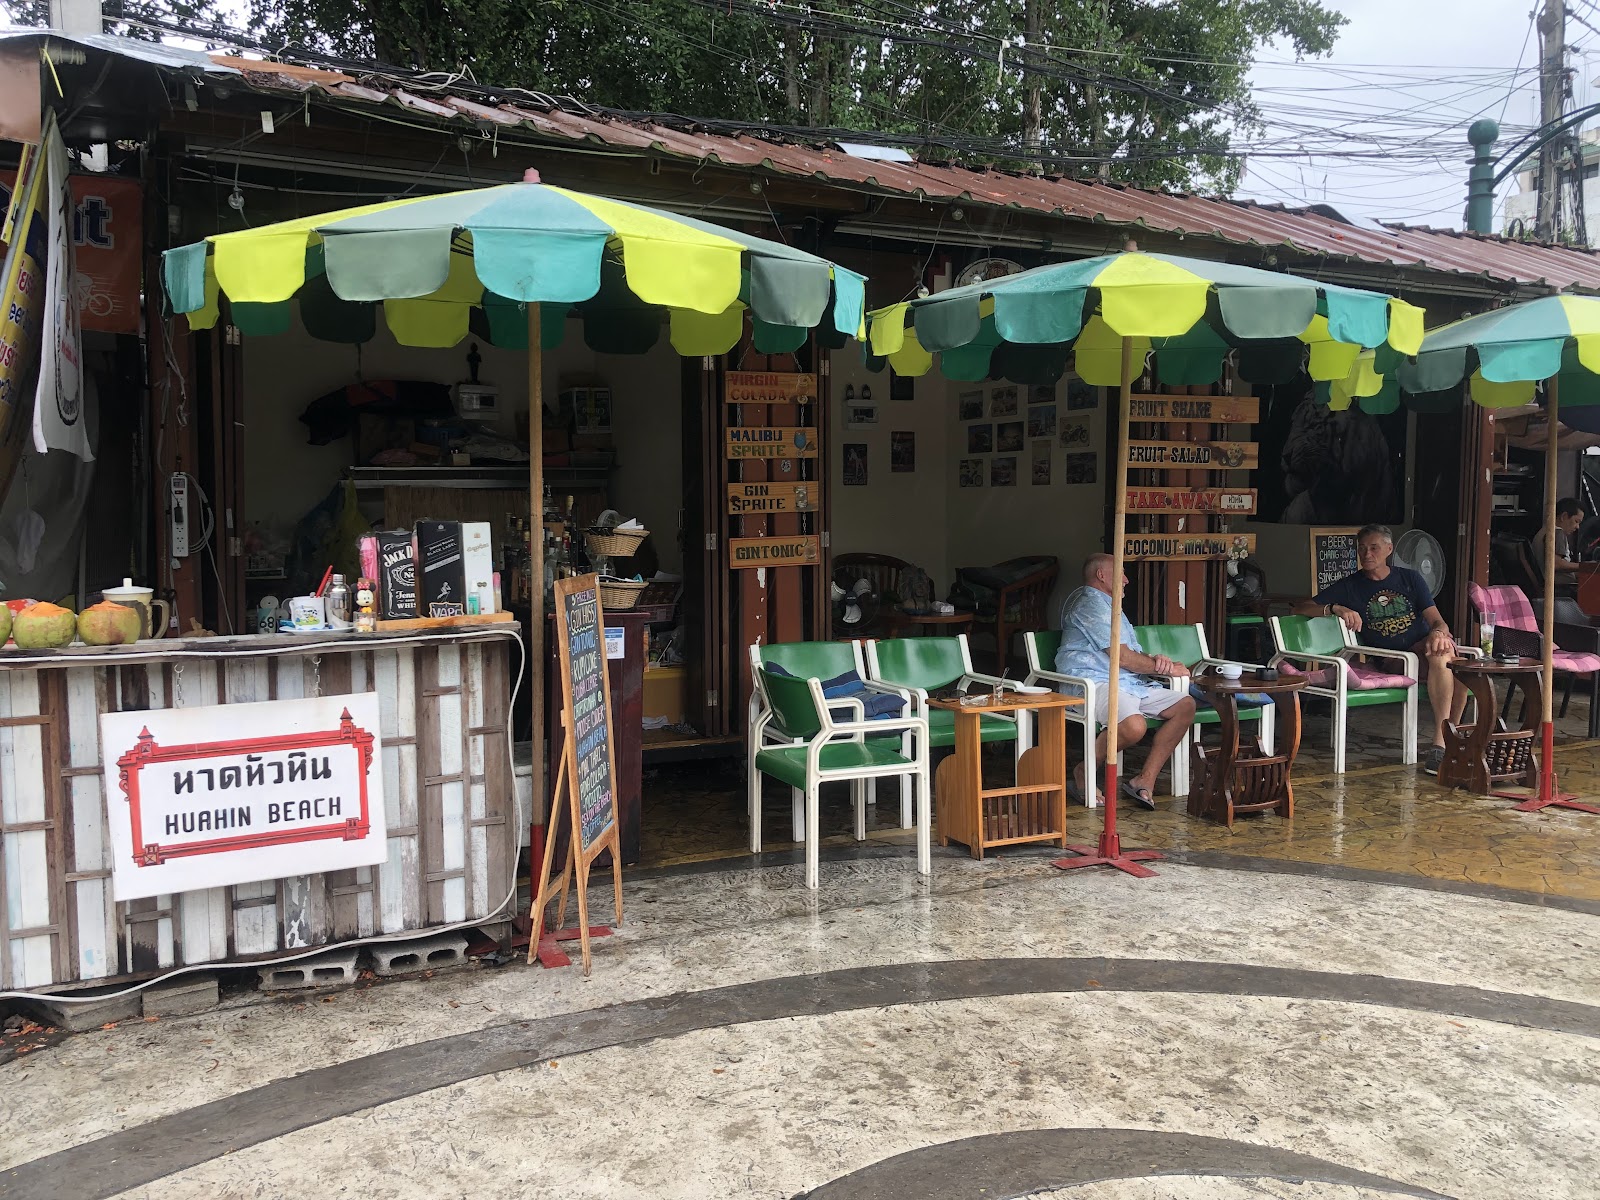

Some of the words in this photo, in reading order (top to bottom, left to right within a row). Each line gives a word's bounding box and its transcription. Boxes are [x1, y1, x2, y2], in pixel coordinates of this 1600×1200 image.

[731, 373, 779, 386] VIRGIN
[730, 389, 787, 401] COLADA
[1129, 400, 1168, 417] FRUIT
[1171, 401, 1211, 418] SHAKE
[731, 429, 783, 442] MALIBU
[731, 444, 787, 457] SPRITE
[1129, 446, 1167, 463] FRUIT
[1171, 447, 1211, 464] SALAD
[744, 485, 769, 496] GIN
[732, 498, 786, 511] SPRITE
[1127, 491, 1166, 509] TAKE
[1171, 492, 1216, 509] AWAY
[1327, 535, 1347, 548] BEER
[382, 549, 407, 568] JACK
[395, 590, 416, 600] Tenn
[165, 805, 251, 835] HUAHIN
[268, 796, 341, 824] BEACH
